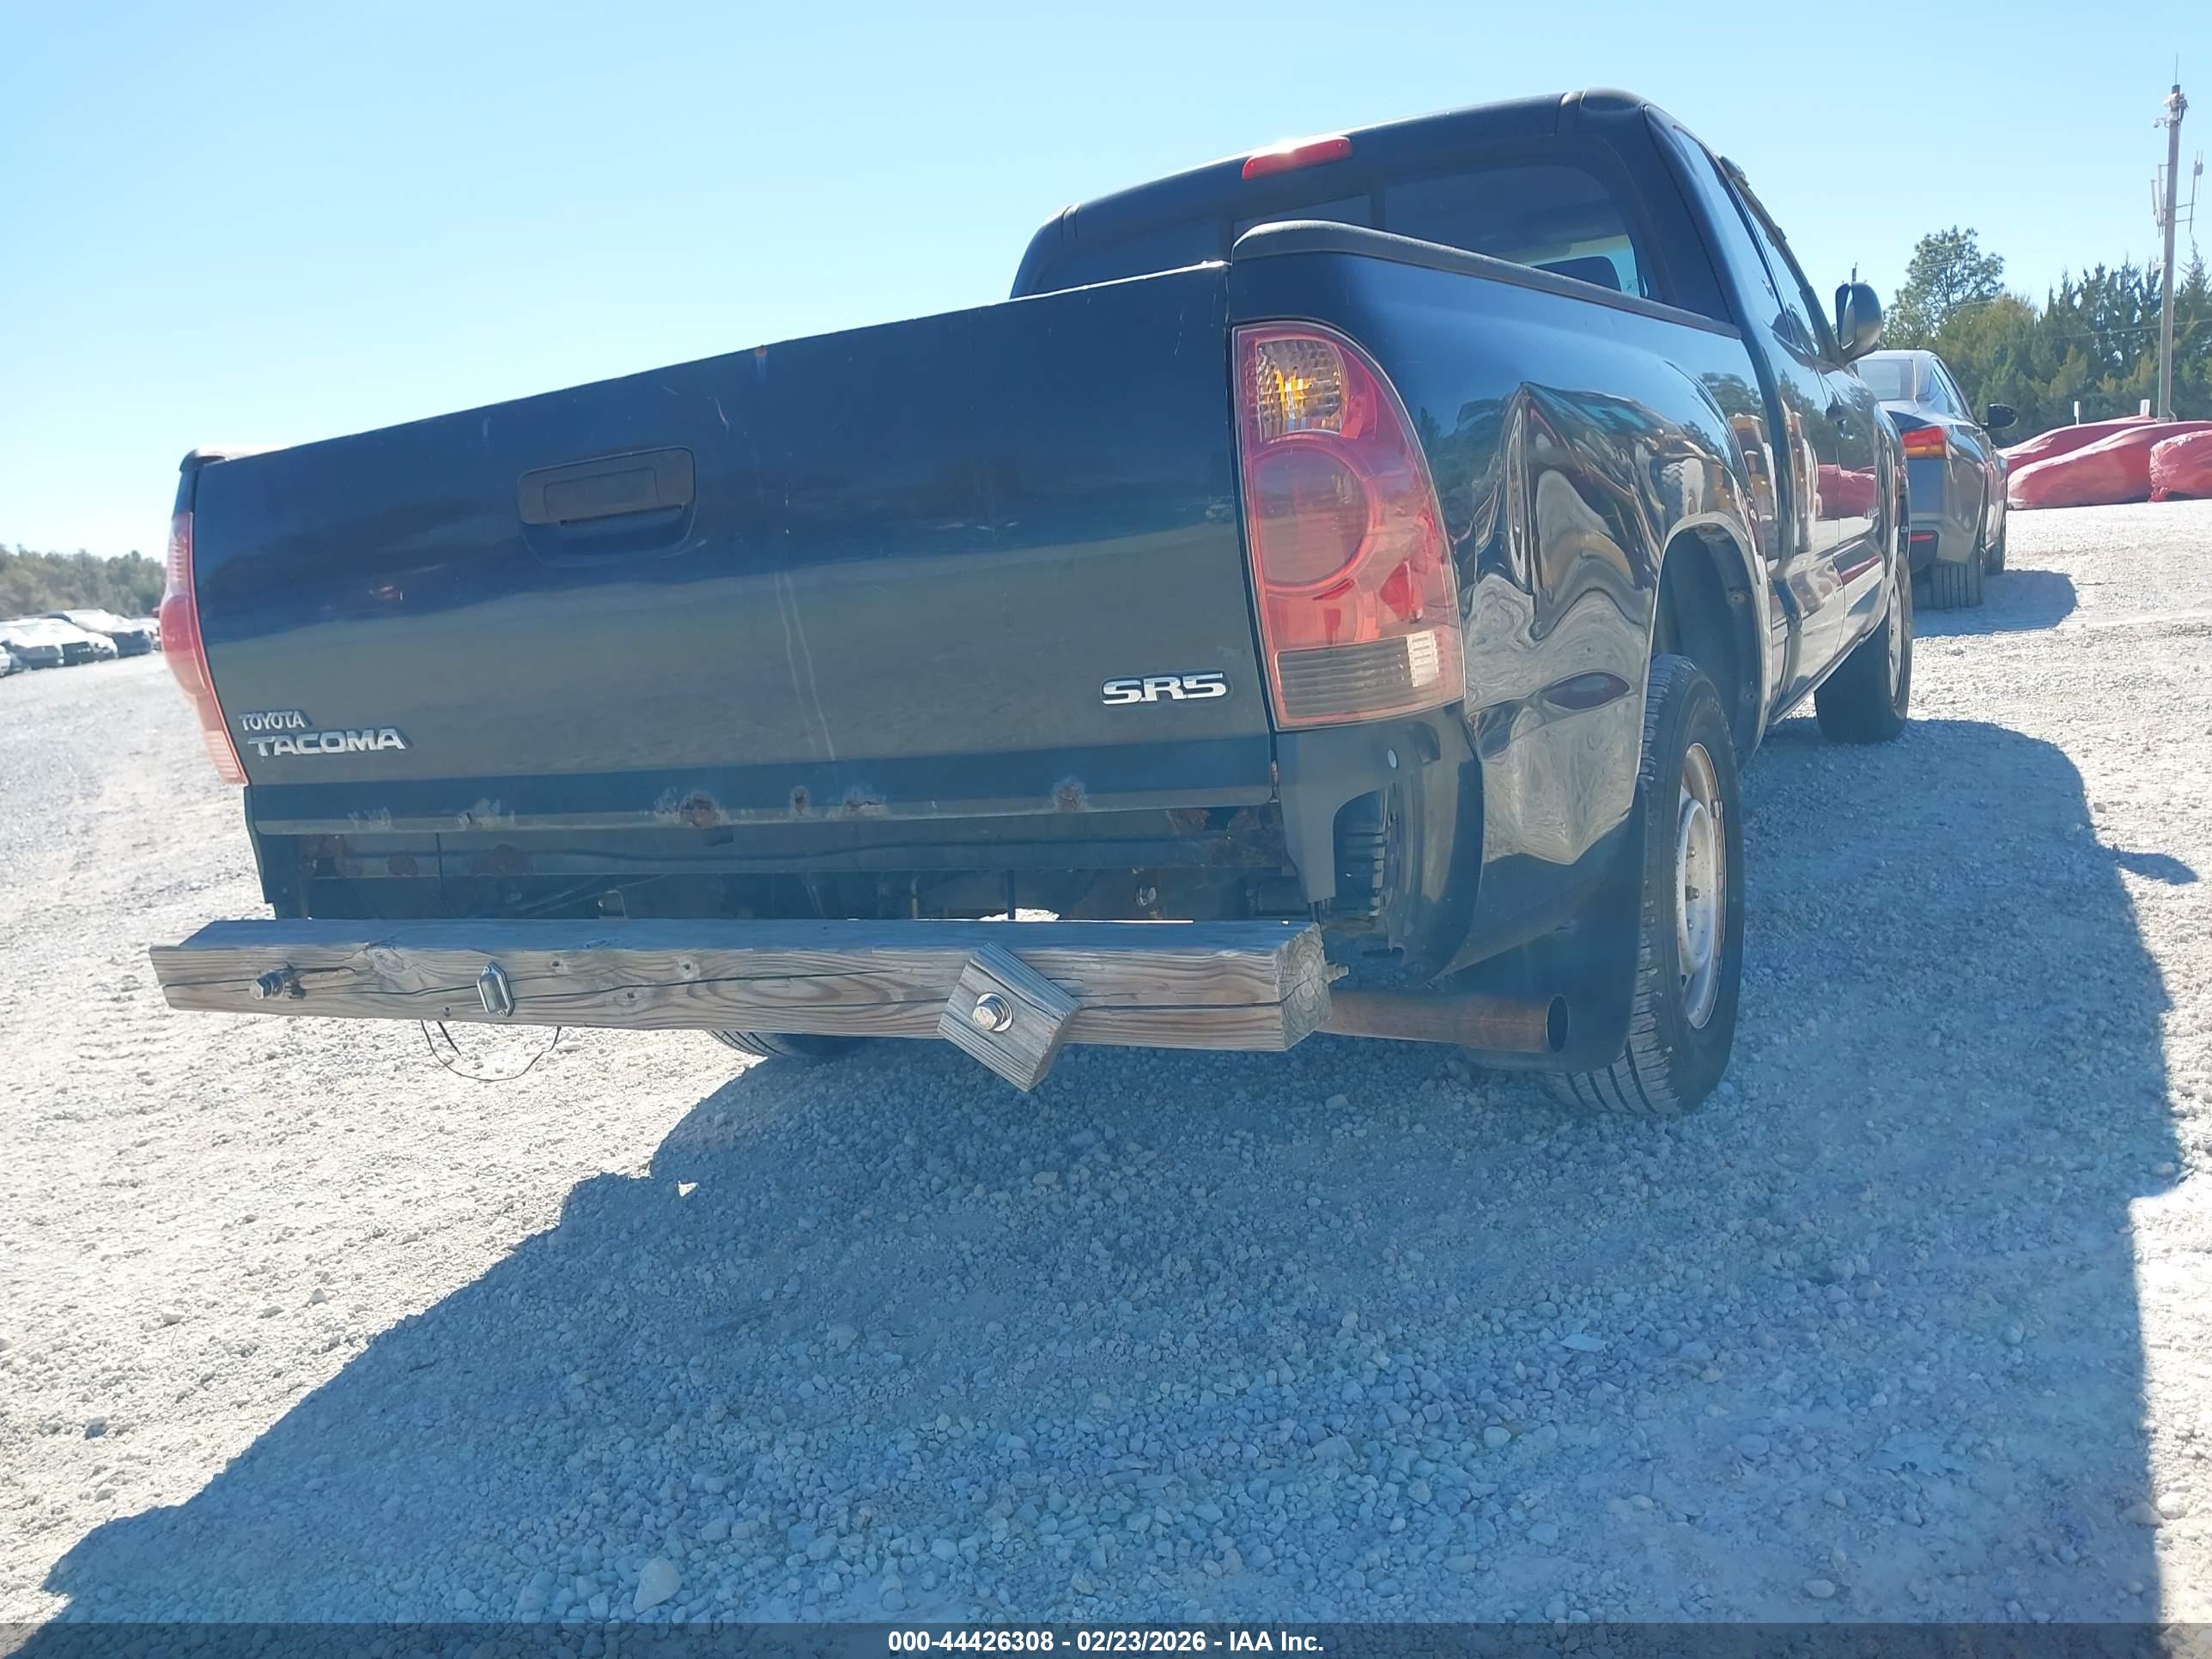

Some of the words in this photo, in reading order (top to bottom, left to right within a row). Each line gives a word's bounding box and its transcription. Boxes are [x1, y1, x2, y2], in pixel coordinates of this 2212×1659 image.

[1102, 672, 1227, 705] SR5
[239, 710, 306, 731] TOYOTA
[247, 728, 406, 757] TACOMA
